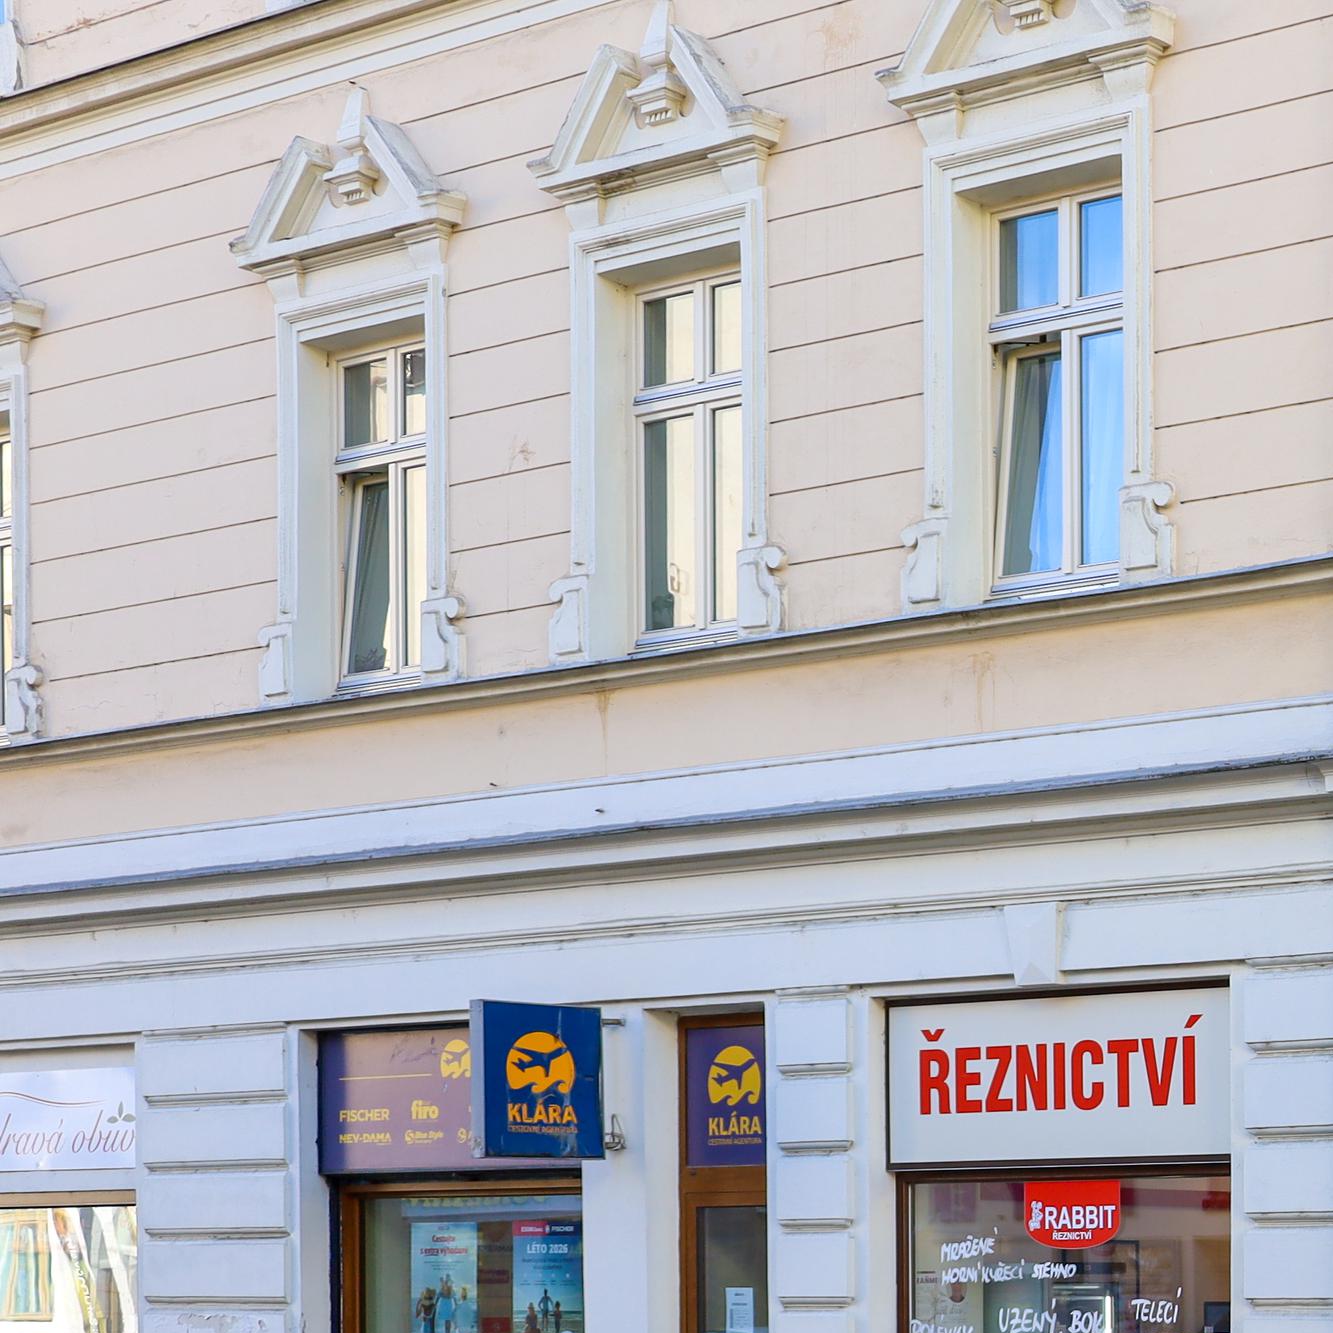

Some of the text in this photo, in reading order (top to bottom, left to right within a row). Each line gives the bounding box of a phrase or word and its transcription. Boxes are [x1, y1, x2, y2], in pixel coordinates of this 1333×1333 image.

[919, 1014, 1203, 1115] ŘEZNICTVÍ
[339, 1099, 440, 1122] FISCHER firo
[507, 1098, 578, 1124] KLÁRA
[71, 1109, 135, 1154] obuv
[708, 1111, 762, 1136] KLÁRA
[1045, 1205, 1115, 1229] RABBIT
[526, 1241, 547, 1254] LÉTO
[1052, 1231, 1092, 1240] ŘEZNICTVÍ
[1032, 1261, 1077, 1279] STEHNO
[1131, 1287, 1182, 1325] TELECÍ
